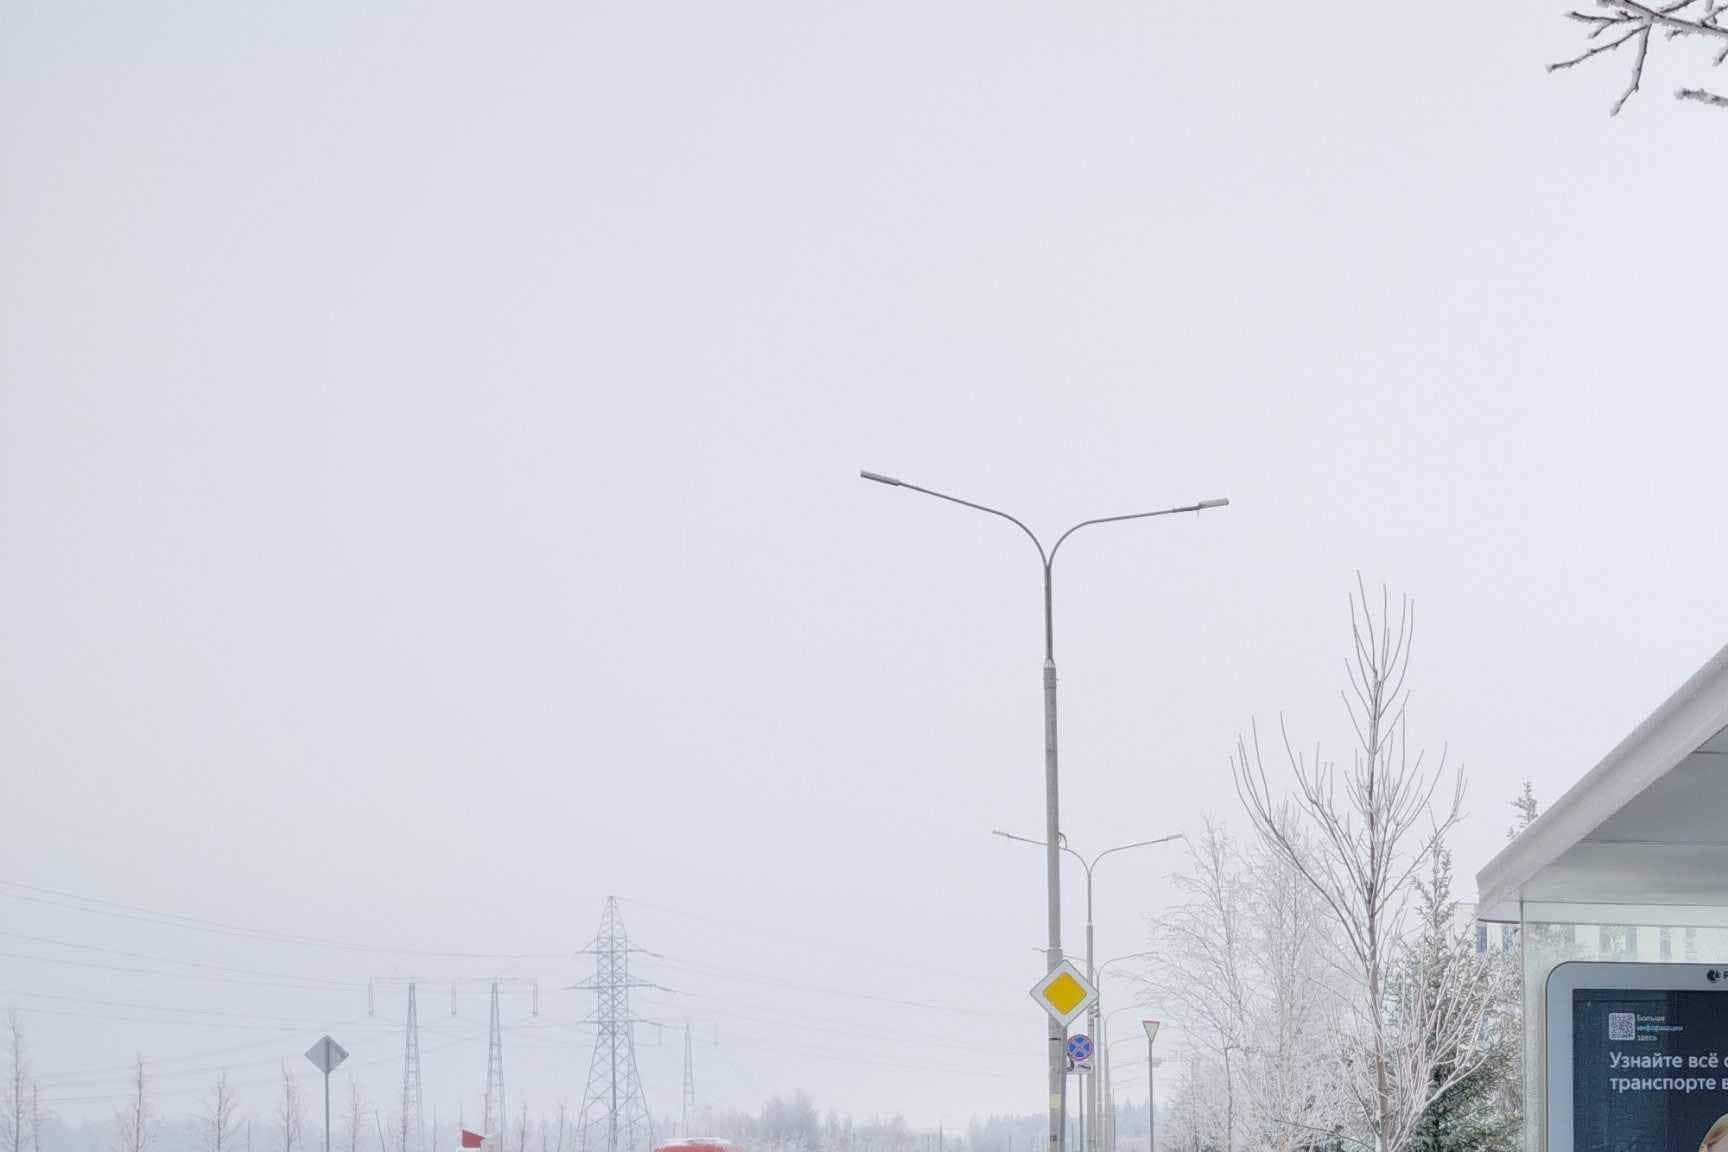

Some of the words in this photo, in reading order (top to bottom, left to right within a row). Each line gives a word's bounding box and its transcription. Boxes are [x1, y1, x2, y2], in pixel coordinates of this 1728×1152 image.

[1609, 1051, 1683, 1069] Узнайте
[1688, 1052, 1719, 1069] всё
[1609, 1077, 1716, 1094] транспорте
